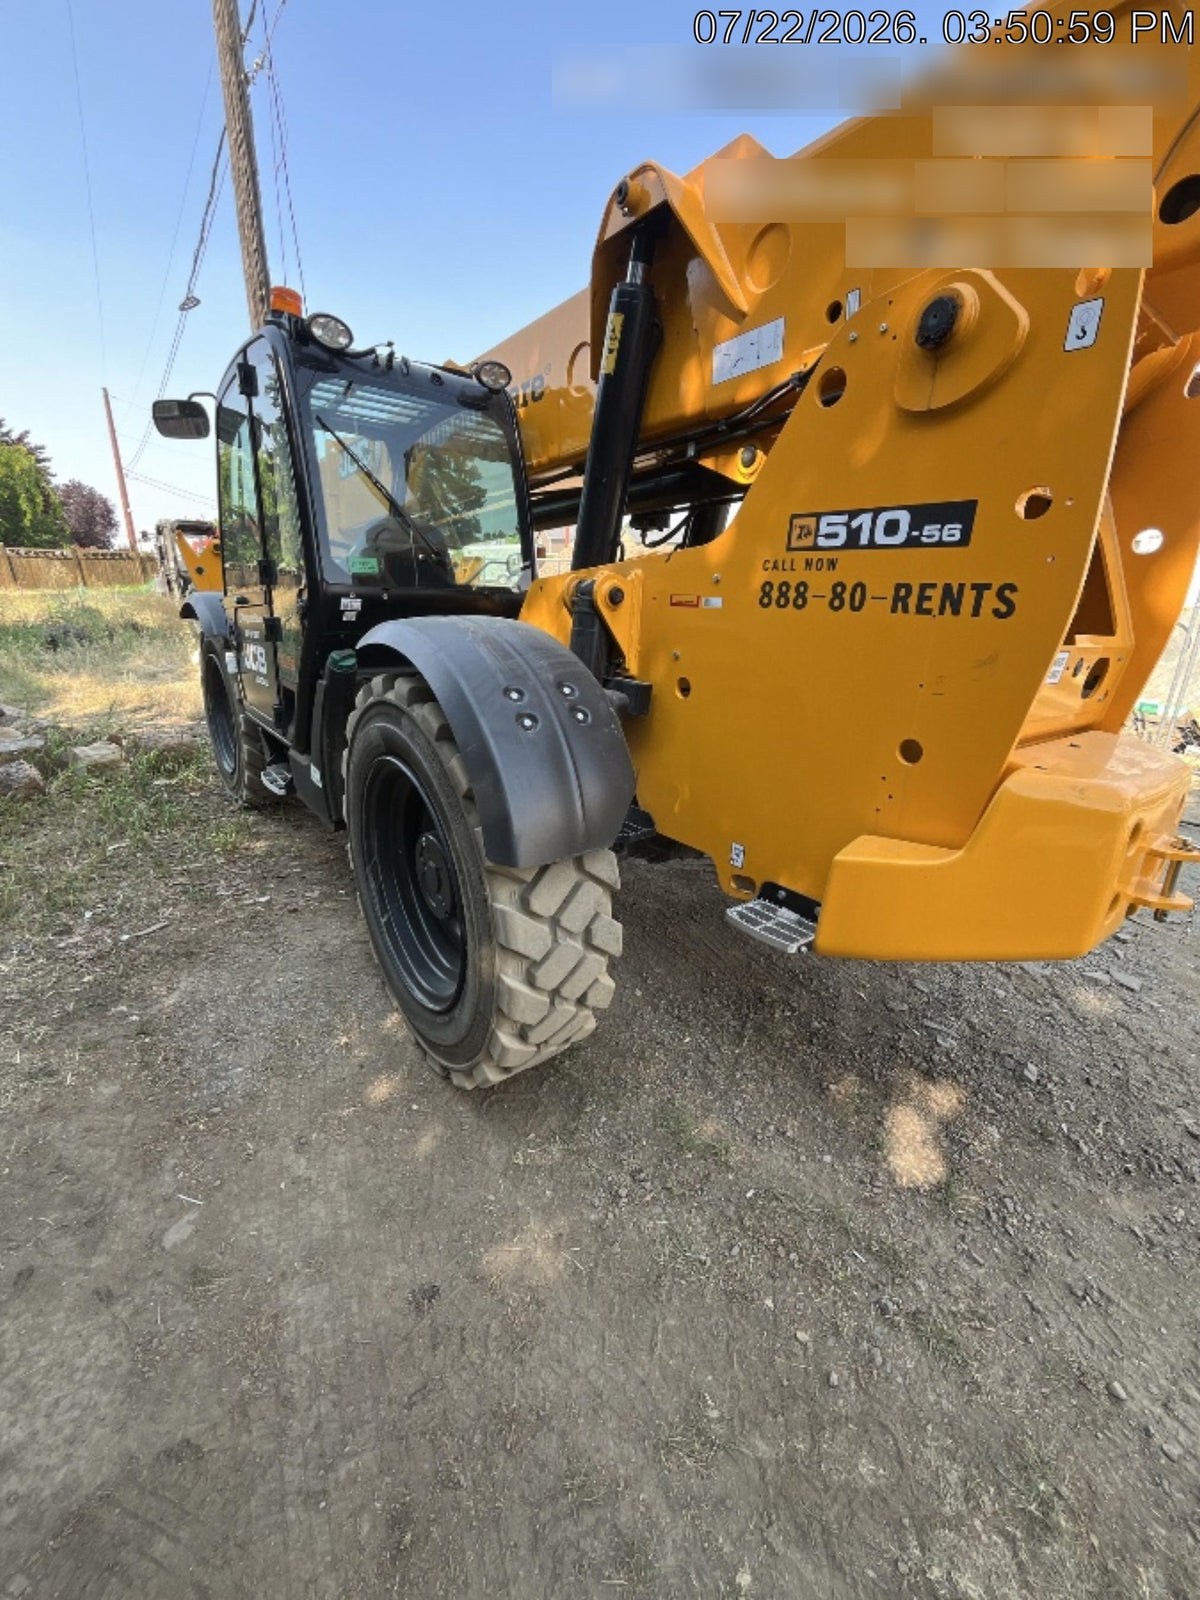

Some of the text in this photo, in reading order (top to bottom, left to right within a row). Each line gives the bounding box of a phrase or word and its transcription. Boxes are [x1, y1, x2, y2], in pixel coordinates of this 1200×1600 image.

[816, 509, 963, 547] 510-56
[762, 557, 839, 572] CALL NOW
[758, 580, 1019, 620] 888-80-RENTS
